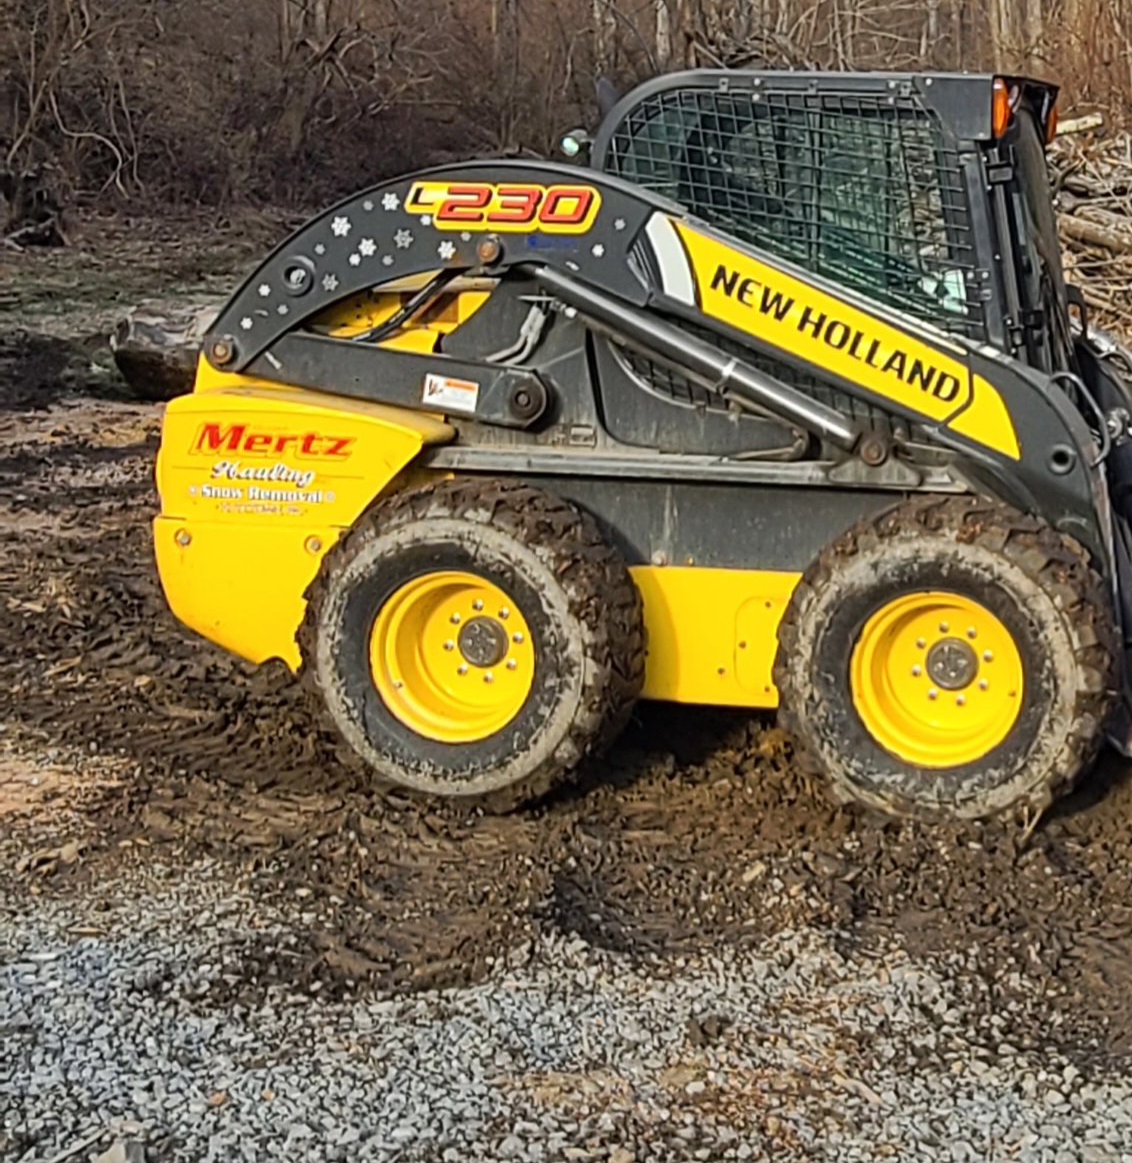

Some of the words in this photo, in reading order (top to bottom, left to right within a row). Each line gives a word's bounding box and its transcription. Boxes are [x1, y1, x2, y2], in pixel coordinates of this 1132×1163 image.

[407, 184, 599, 229] L230
[710, 264, 795, 322] NEW
[796, 305, 961, 403] HOLLAND
[193, 422, 357, 458] Mertz
[211, 461, 315, 488] Hauling
[201, 485, 243, 498] Snow
[248, 486, 322, 504] Removal
